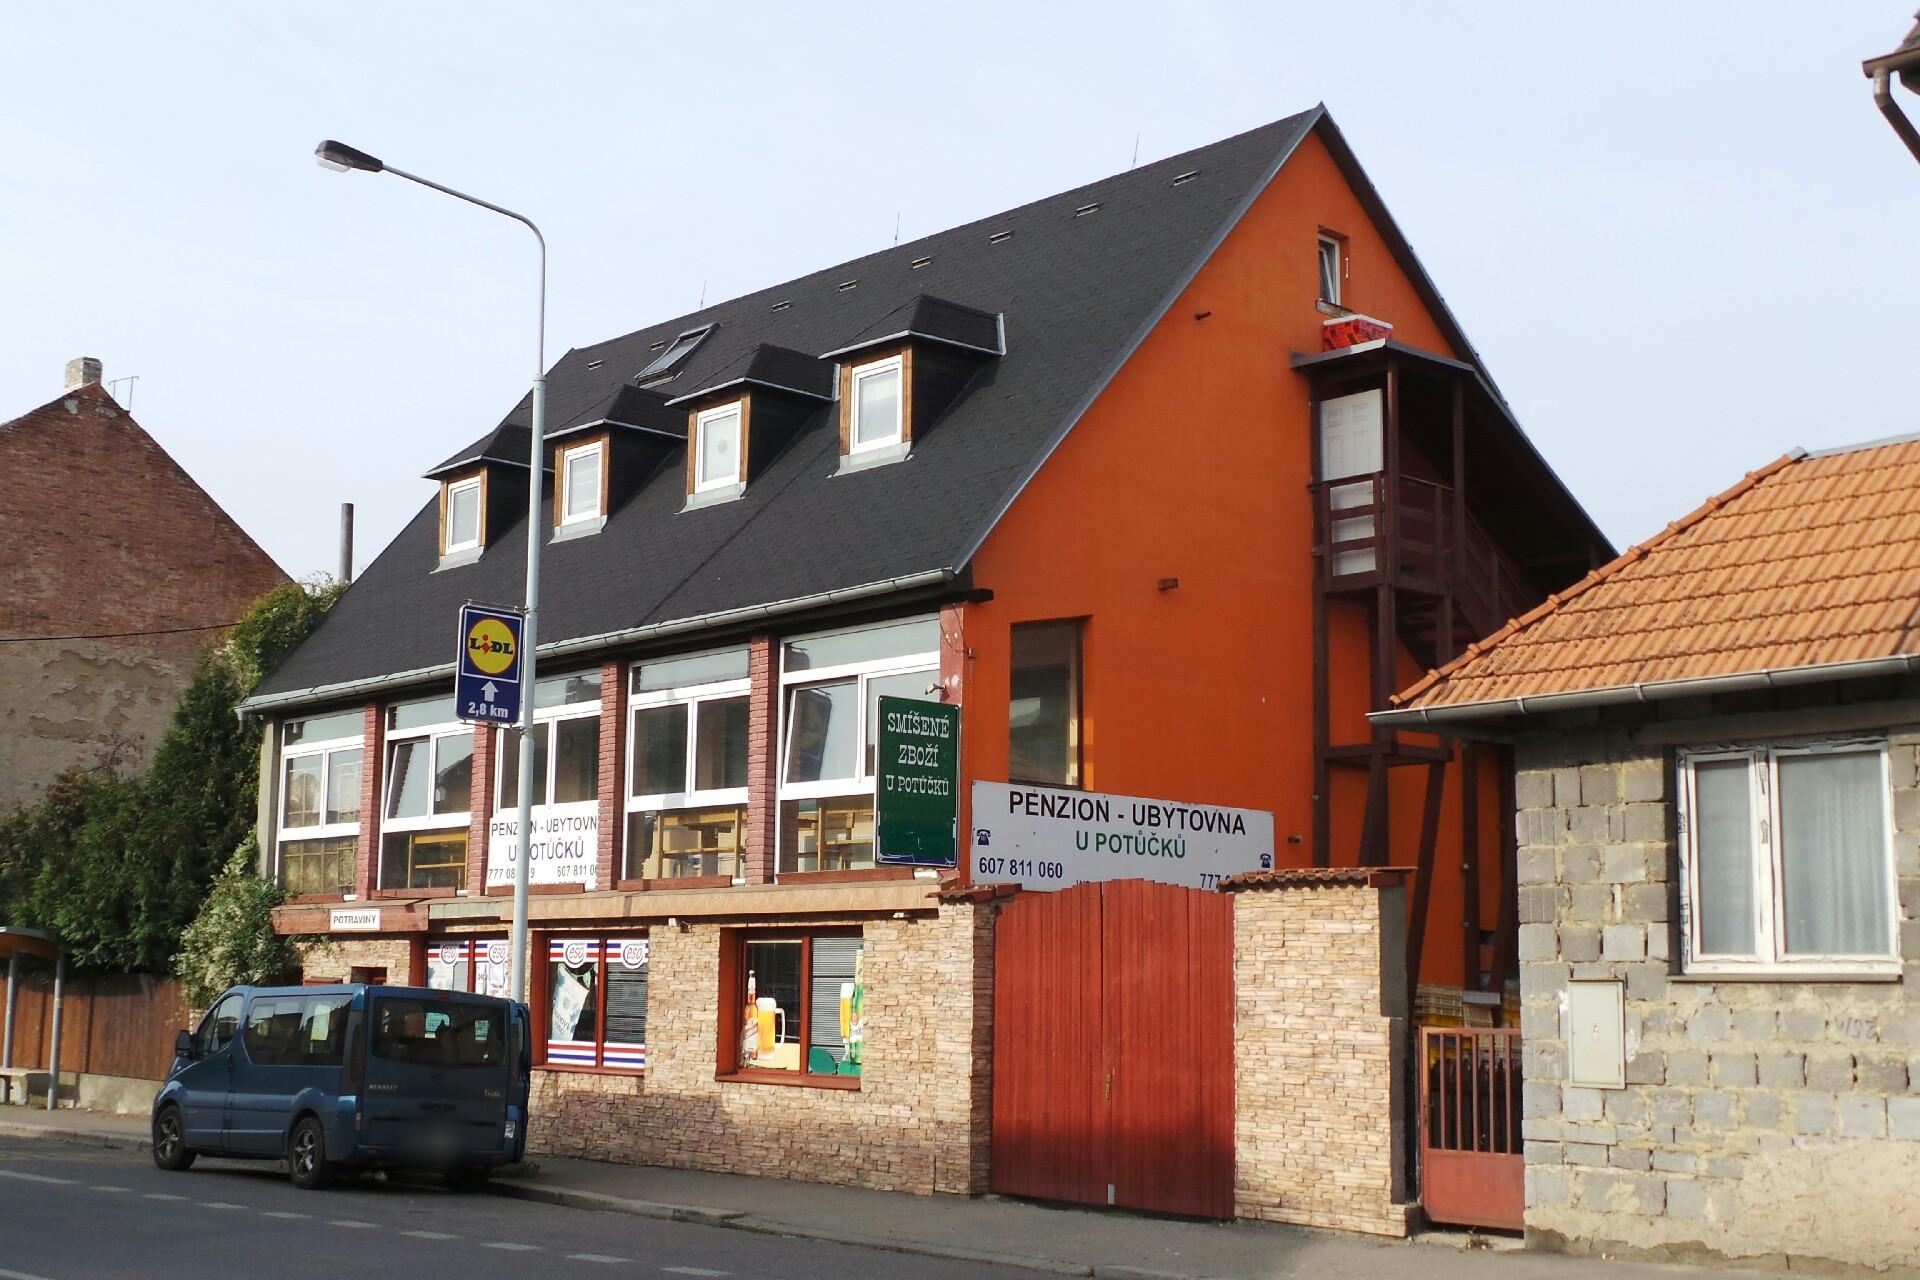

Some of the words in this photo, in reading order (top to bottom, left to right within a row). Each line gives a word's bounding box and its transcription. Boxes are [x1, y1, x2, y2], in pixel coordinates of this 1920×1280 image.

[468, 702, 487, 717] 2,8
[490, 704, 509, 719] km
[887, 710, 950, 739] SMÍŠENÉ
[898, 742, 939, 768] ZBOŽÍ
[886, 774, 895, 791] U
[1009, 790, 1110, 823] PENZION
[1132, 803, 1247, 836] UBYTOVNA
[491, 819, 538, 837] PENZN
[546, 815, 597, 833] UBYTOVN
[508, 844, 517, 862] U
[529, 836, 584, 861] OTŮČKŮ
[1076, 830, 1089, 851] U
[1095, 829, 1186, 859] POTŮČKŮ
[488, 868, 503, 880] 777
[557, 864, 571, 878] 607
[573, 863, 587, 877] 811
[979, 856, 1005, 875] 607
[1009, 858, 1033, 877] 811
[1038, 860, 1063, 879] 060
[333, 914, 377, 925] POTRAVINY
